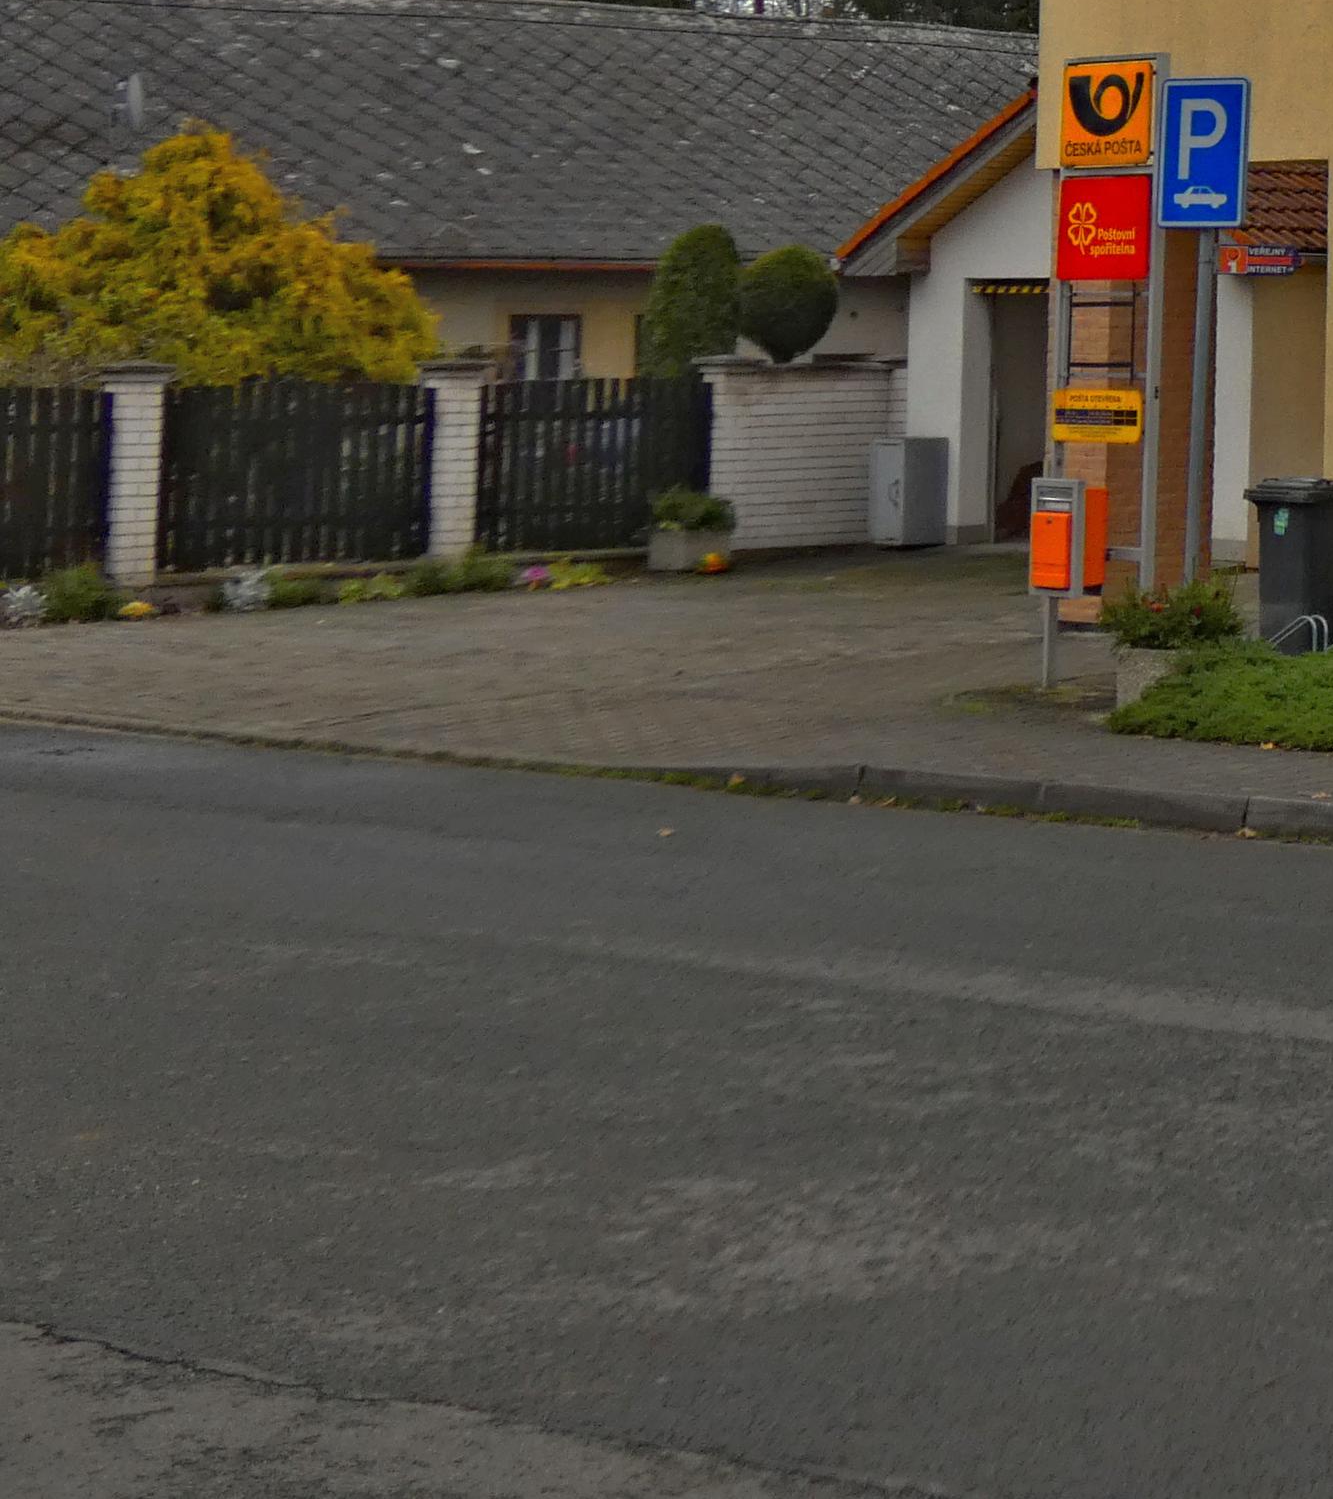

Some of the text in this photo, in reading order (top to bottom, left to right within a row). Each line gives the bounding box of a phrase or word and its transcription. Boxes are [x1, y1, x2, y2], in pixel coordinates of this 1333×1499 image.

[1064, 137, 1142, 157] ČESKÁ POŠTA
[1178, 98, 1227, 180] P
[1097, 227, 1135, 240] Poštovní
[1089, 242, 1135, 258] spořitelna
